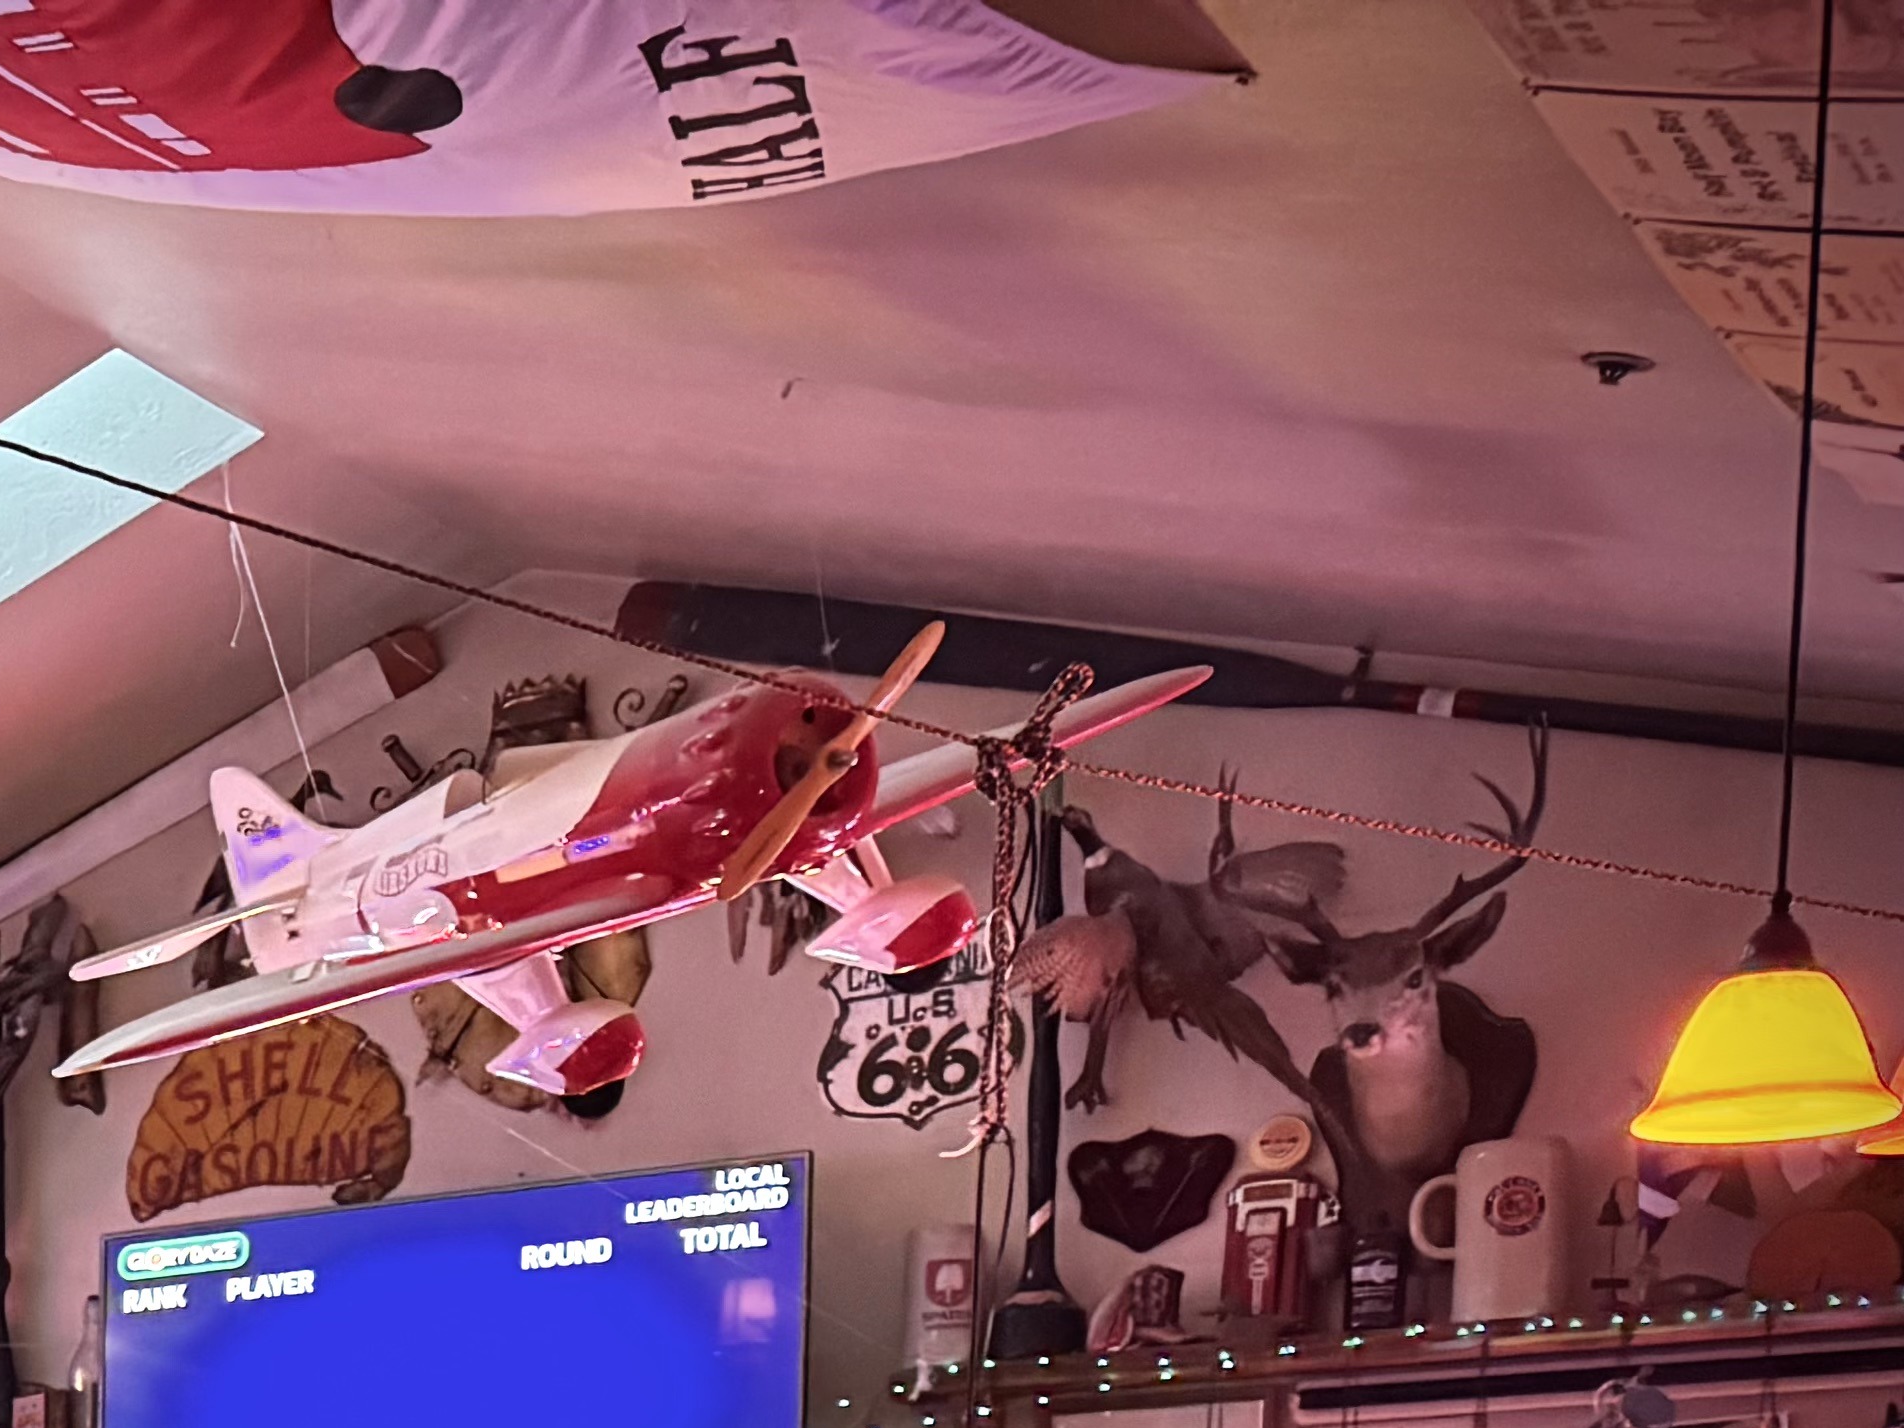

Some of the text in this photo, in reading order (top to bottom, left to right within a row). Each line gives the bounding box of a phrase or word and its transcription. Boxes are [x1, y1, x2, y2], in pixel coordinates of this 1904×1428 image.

[174, 1041, 358, 1126] SHELL
[857, 1022, 983, 1108] 66
[137, 1122, 392, 1203] GASOLINE
[715, 1163, 790, 1192] LOCAL
[625, 1186, 790, 1226] LEADERBOARD
[521, 1222, 767, 1272] ROUND TOTAL
[122, 1268, 315, 1316] RANK PLAYER
